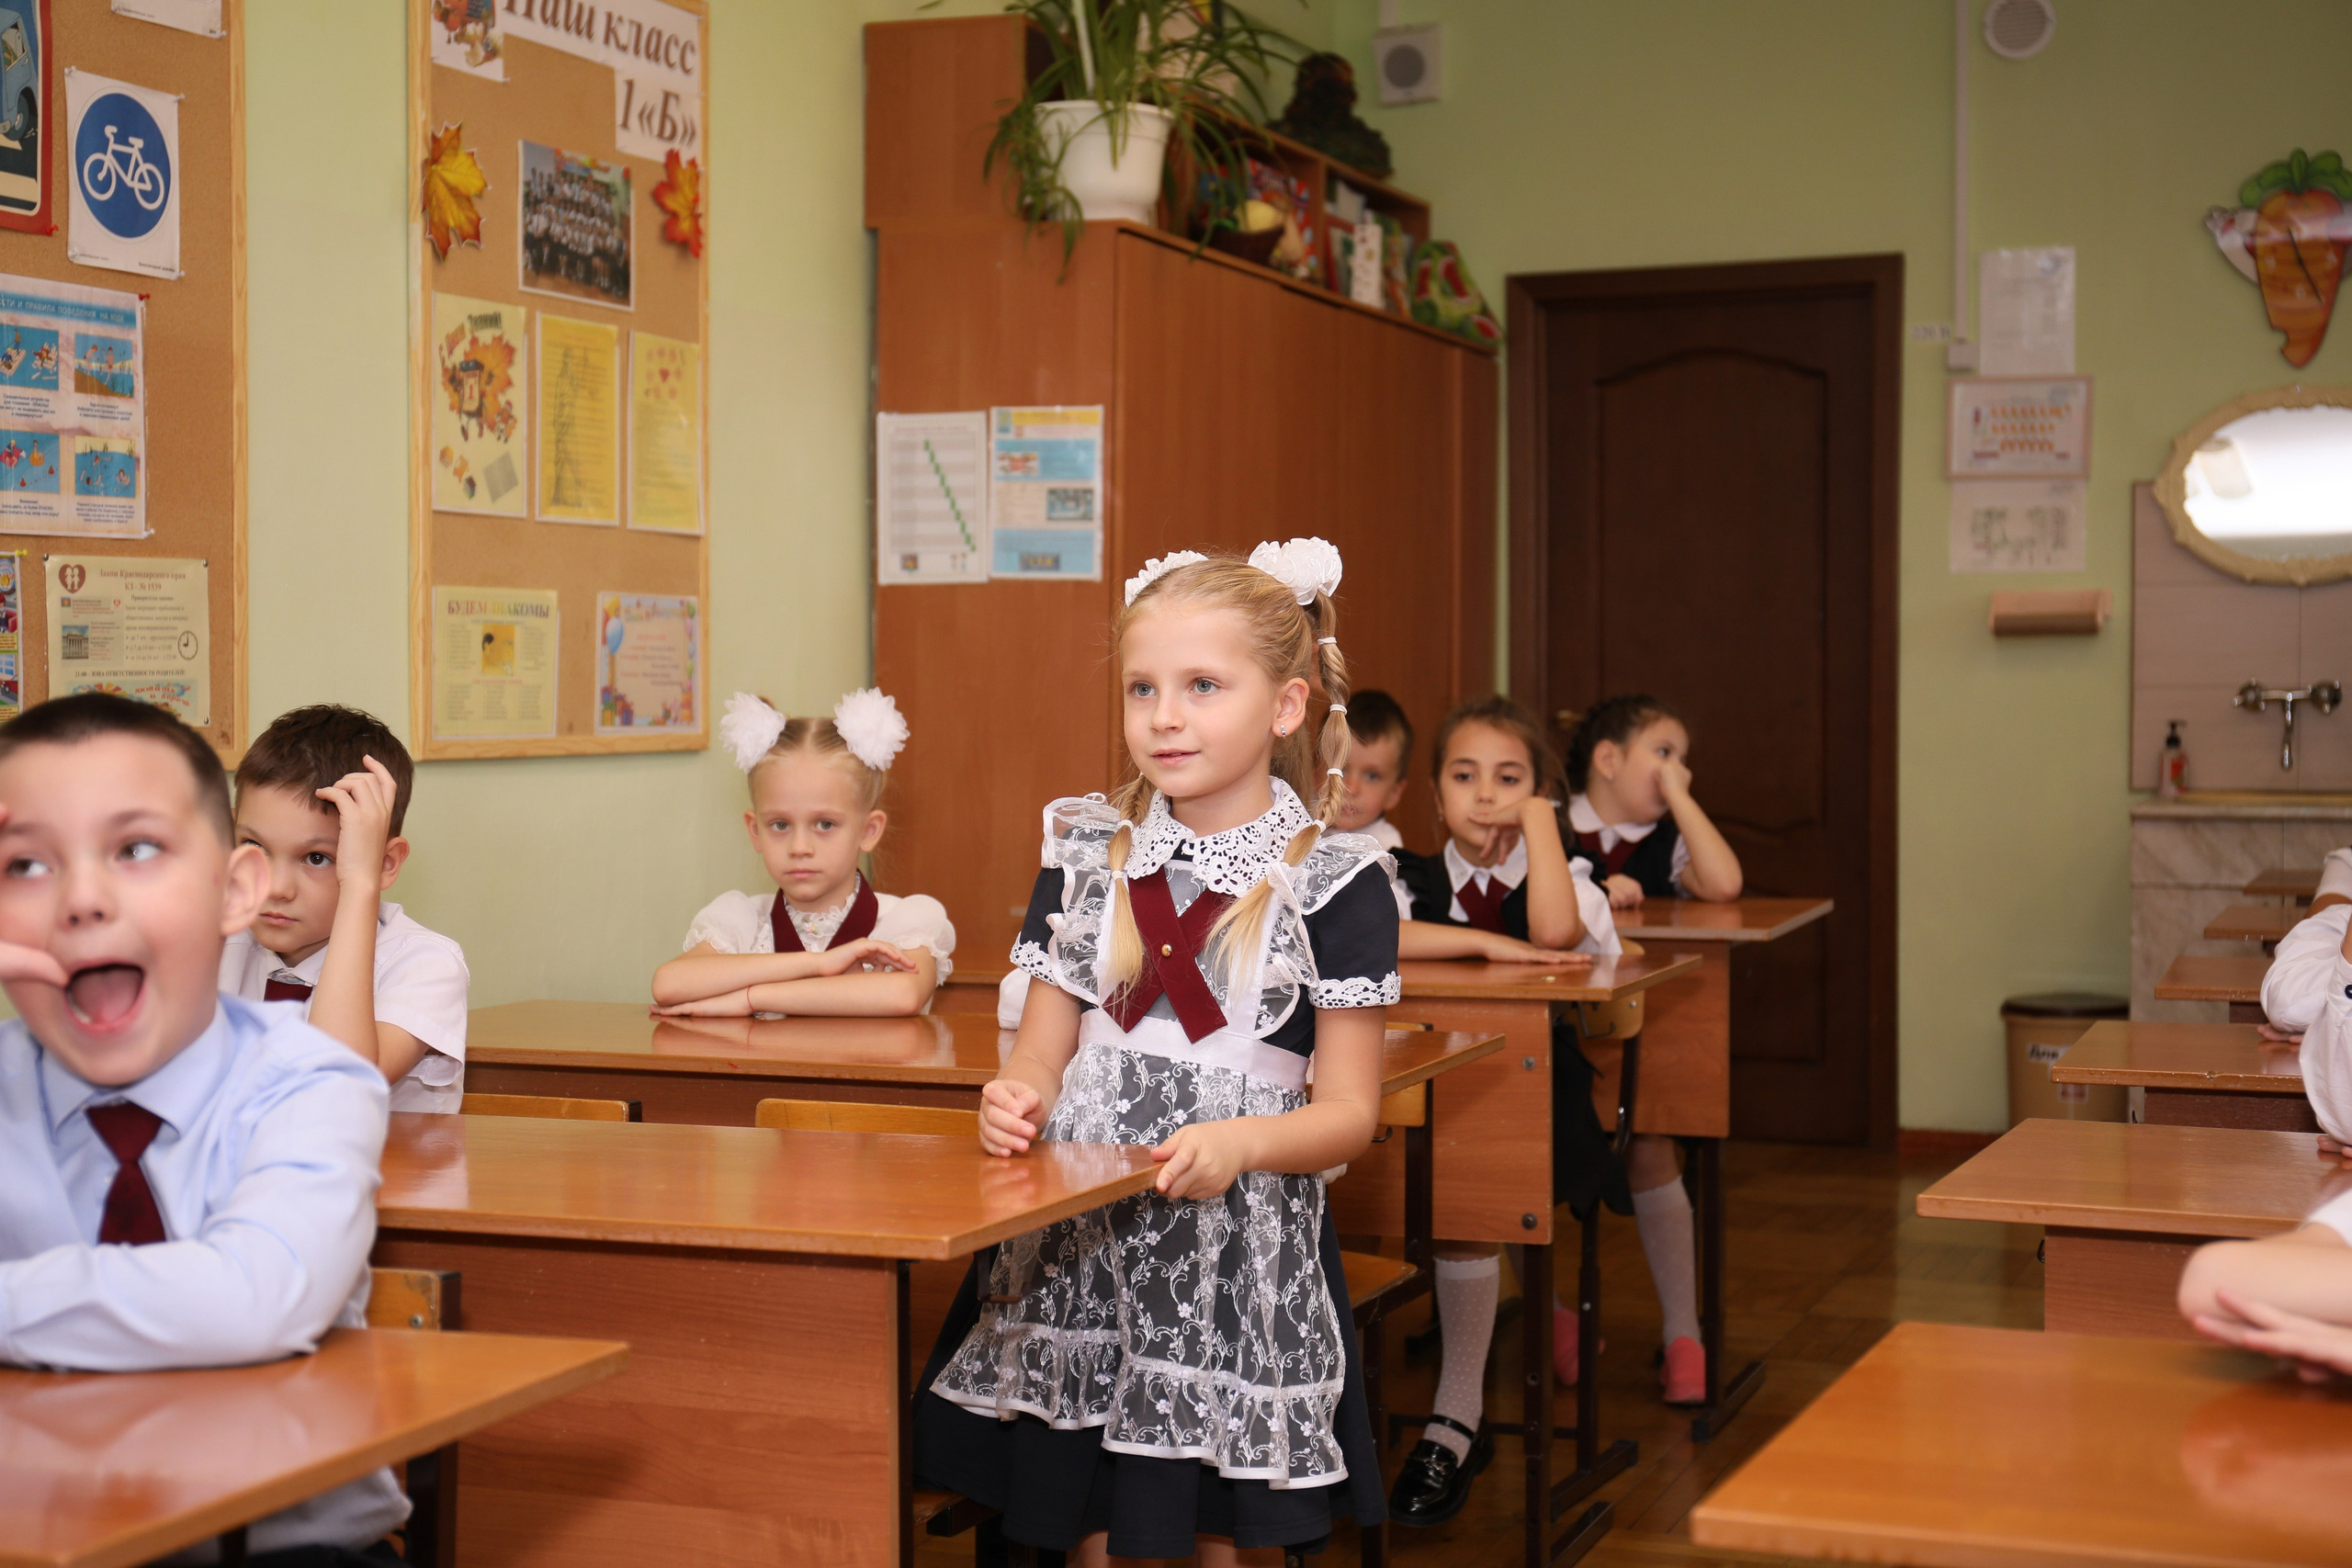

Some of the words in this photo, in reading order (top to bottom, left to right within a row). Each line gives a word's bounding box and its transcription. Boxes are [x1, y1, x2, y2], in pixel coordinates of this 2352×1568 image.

[603, 11, 697, 75] класс
[25, 301, 55, 312] ПРАВИЛА
[58, 307, 96, 319] ПОВЕДЕНИЯ
[100, 569, 119, 579] Закон
[119, 569, 169, 581] Краснодарского
[447, 600, 488, 617] БУДЕМ
[492, 601, 549, 619] ЗНАКОМЫ
